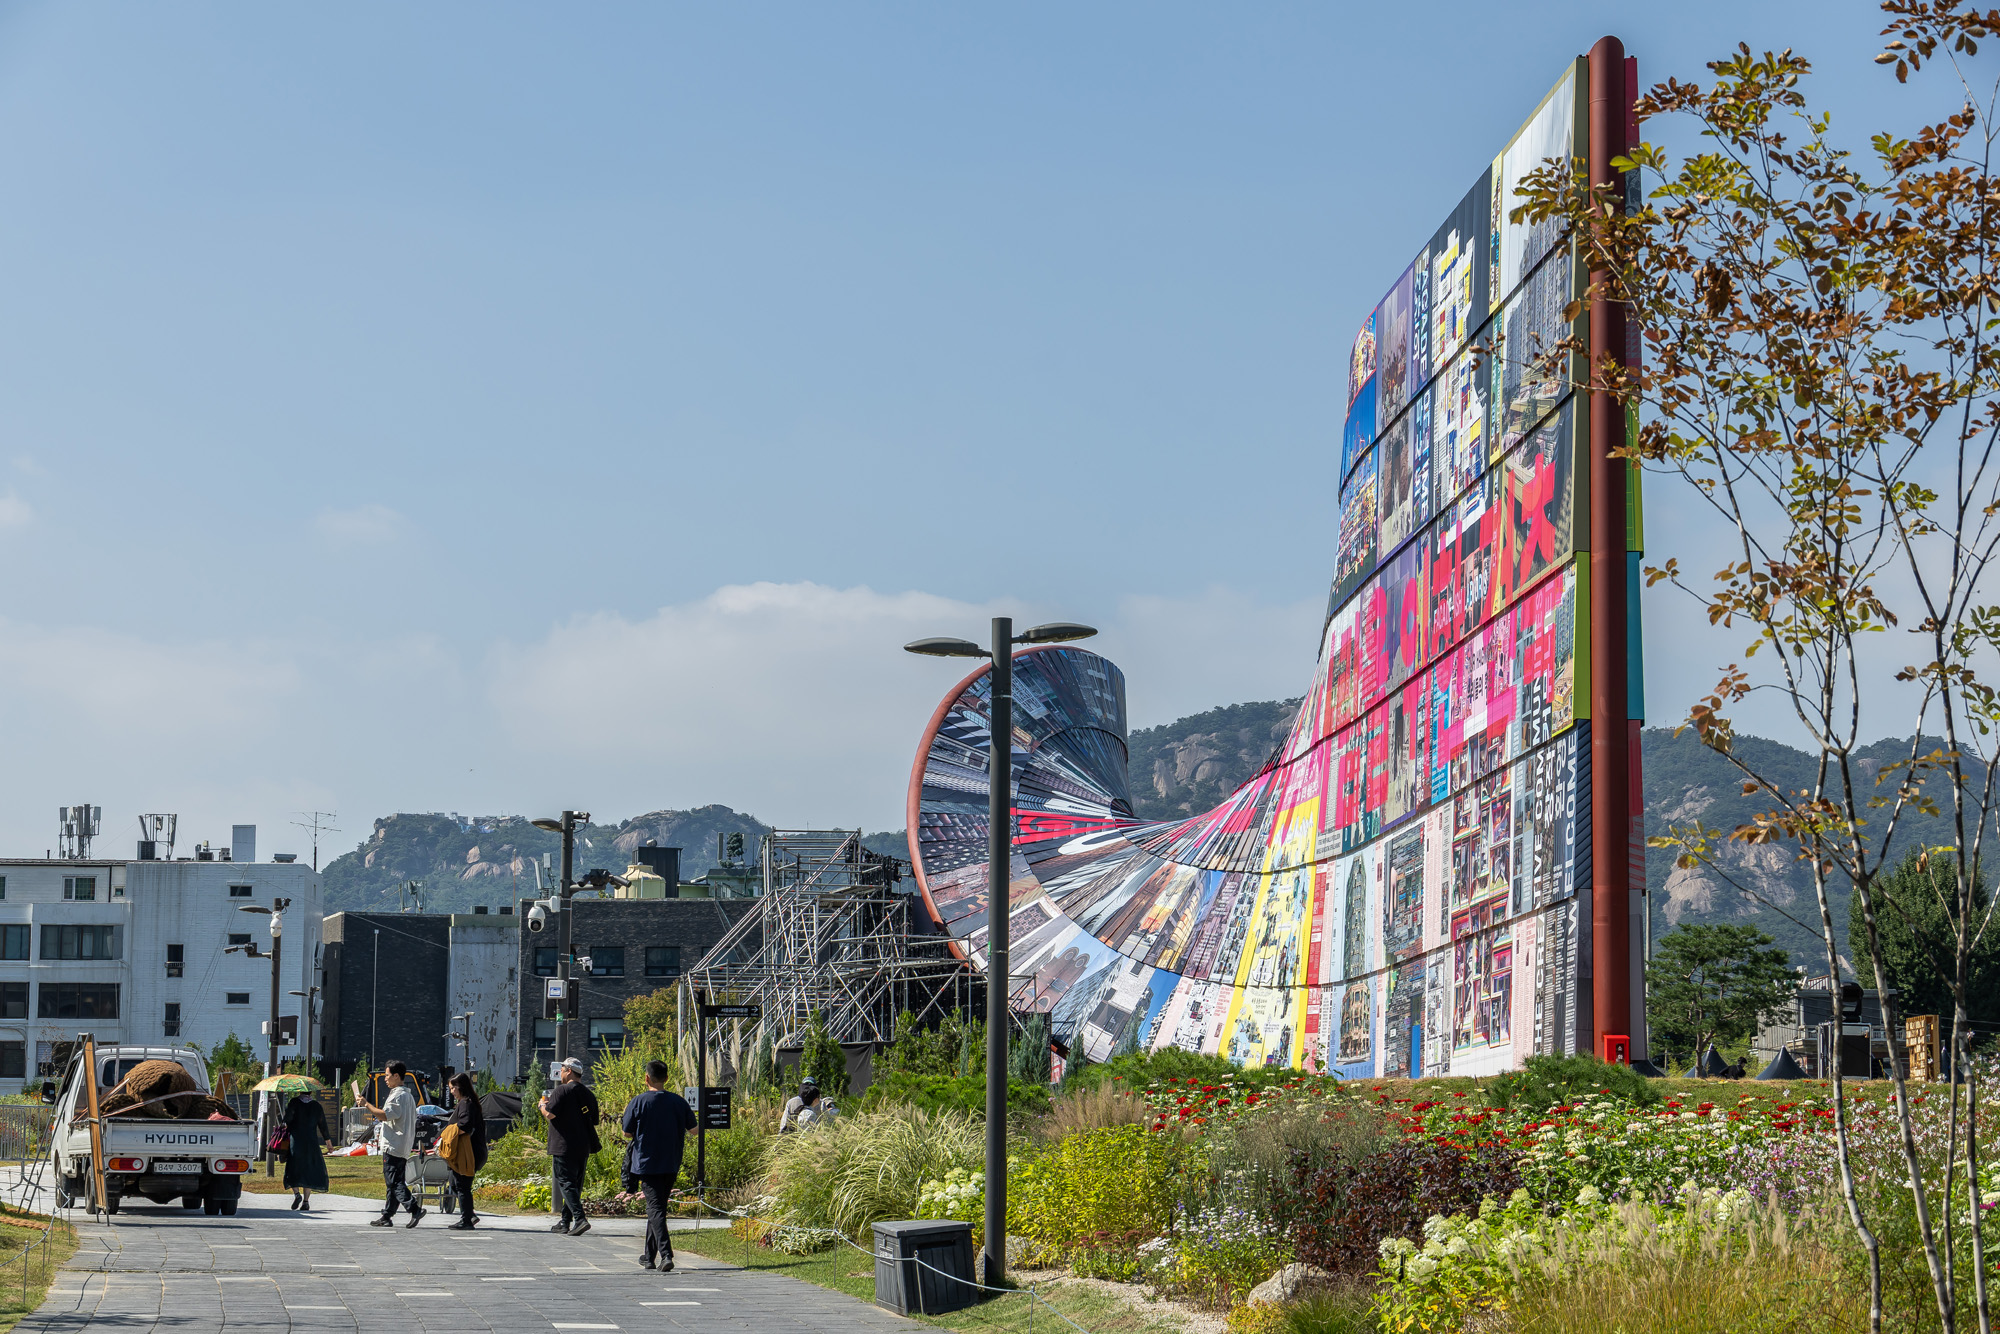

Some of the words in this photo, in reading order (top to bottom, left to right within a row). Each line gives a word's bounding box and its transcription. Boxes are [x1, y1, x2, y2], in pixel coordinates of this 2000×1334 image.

[1555, 738, 1567, 819] 환영
[1565, 731, 1577, 935] WELCOME
[1534, 833, 1545, 988] CREATIVE
[145, 1134, 214, 1145] HYUNDAI
[177, 1163, 198, 1172] 3607
